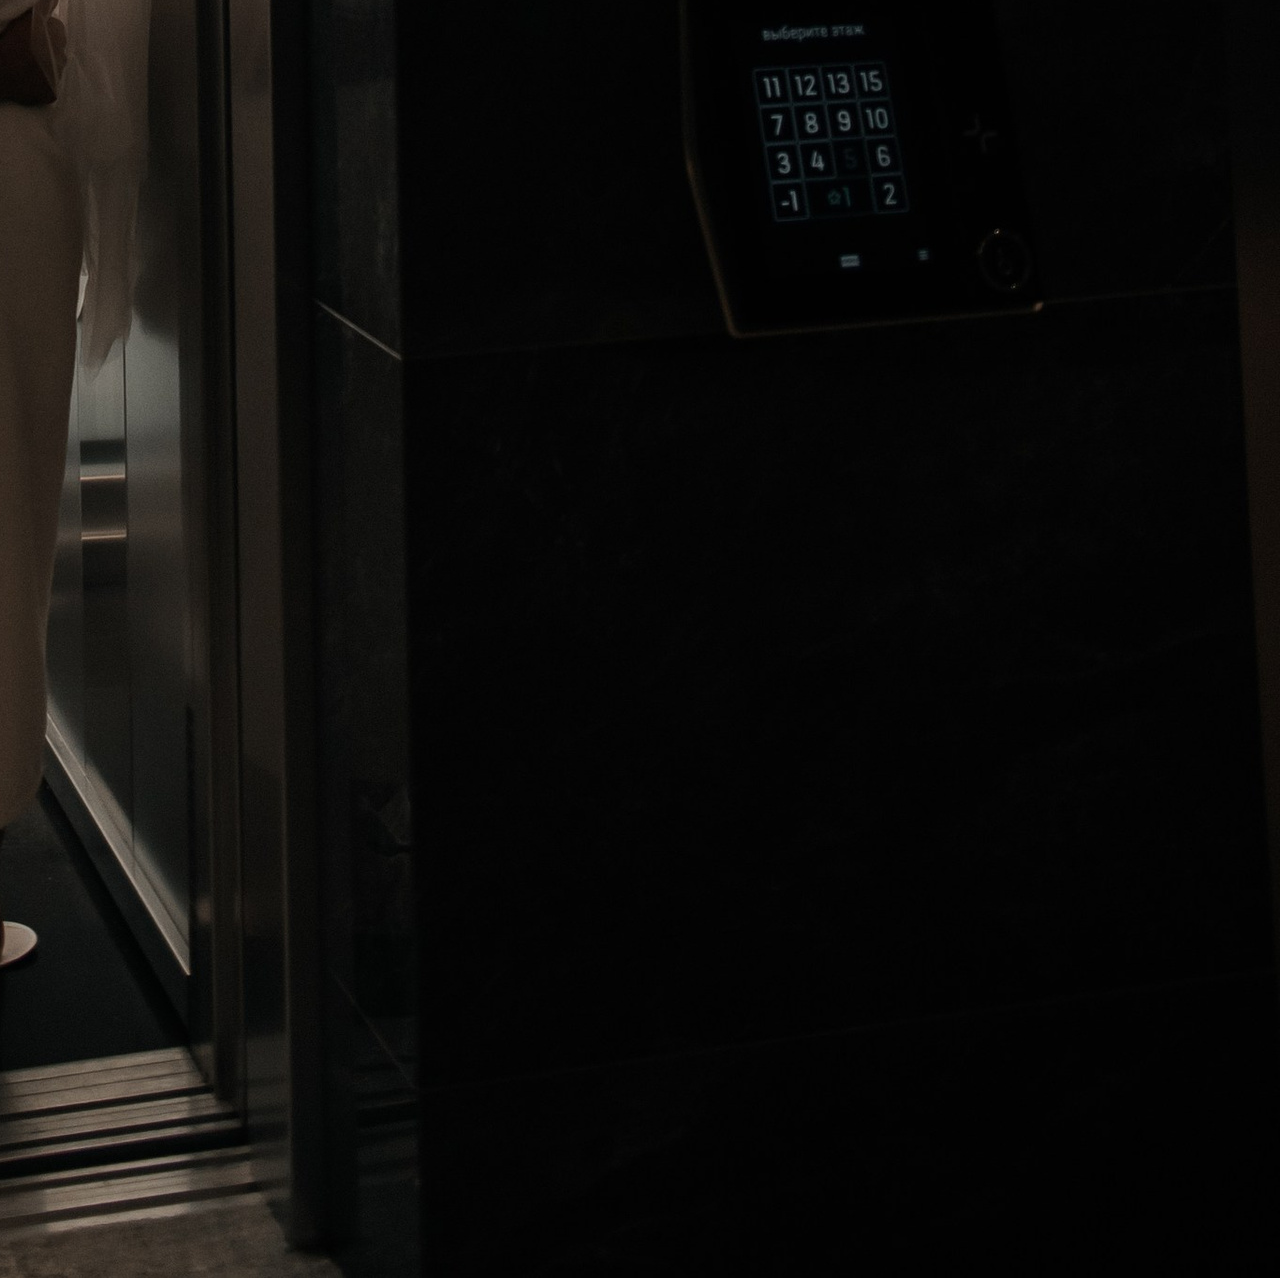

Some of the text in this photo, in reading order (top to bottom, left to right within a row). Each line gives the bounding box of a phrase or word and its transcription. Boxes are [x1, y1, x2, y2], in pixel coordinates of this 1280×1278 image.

[762, 23, 865, 42] выберите этаж
[763, 69, 883, 99] 11 12 13 15
[771, 107, 889, 136] 7 8 9 10
[776, 152, 791, 174] 3
[810, 150, 825, 172] 4
[875, 145, 891, 167] 6
[780, 190, 799, 212] -1
[882, 183, 897, 206] 2
